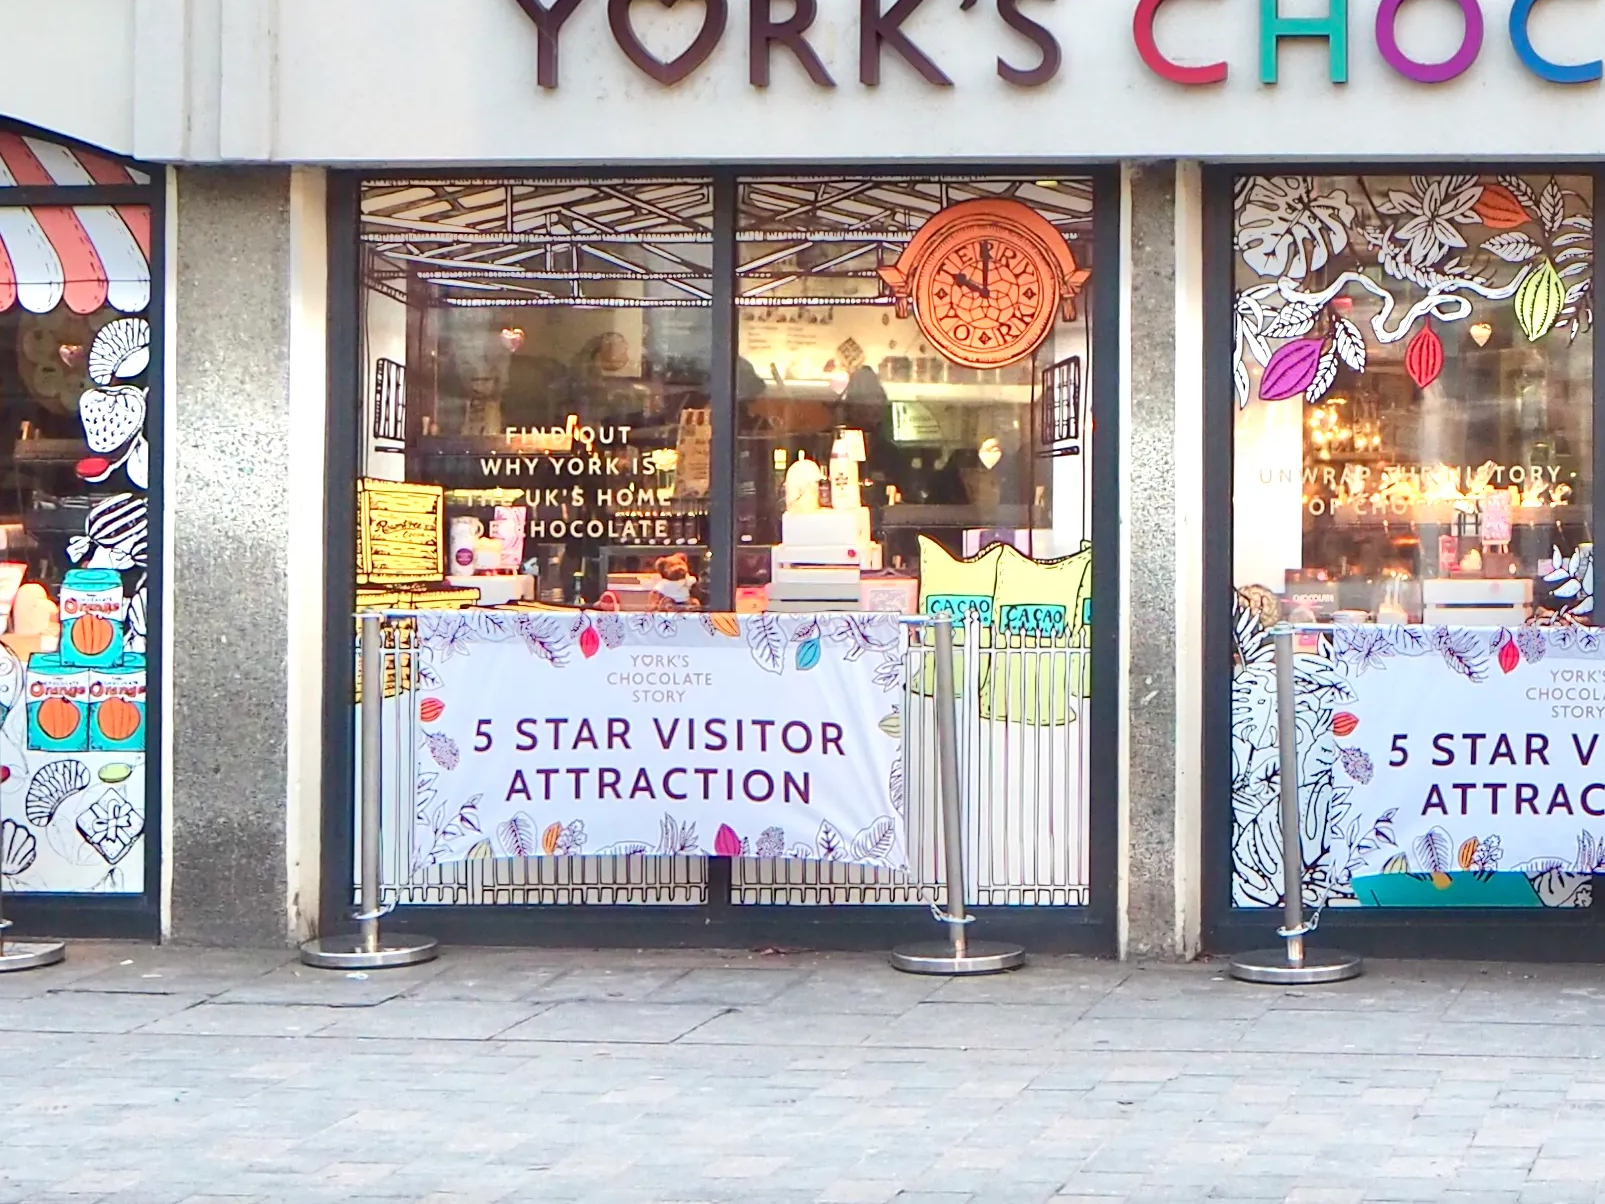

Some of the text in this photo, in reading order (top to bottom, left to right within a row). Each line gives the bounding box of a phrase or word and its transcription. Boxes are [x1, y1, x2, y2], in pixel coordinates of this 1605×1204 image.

[938, 303, 1036, 346] YORK
[505, 426, 631, 445] FIND OUT
[480, 457, 656, 476] WHY YORK IS
[1447, 465, 1562, 484] HITORY
[525, 488, 585, 507] UK'S
[597, 487, 672, 507] HOME
[522, 519, 669, 538] HOCOLATE
[930, 599, 991, 616] CACAO
[1006, 605, 1063, 624] CACAO
[606, 671, 714, 688] CHOCOLATE
[29, 681, 86, 699] Orange
[632, 688, 687, 704] STORY
[1550, 704, 1605, 721] STORY
[473, 716, 847, 757] 5 STAR VISITOR
[1388, 733, 1409, 768] 5
[1431, 731, 1551, 767] STAR
[505, 766, 812, 805] ATTRACTION
